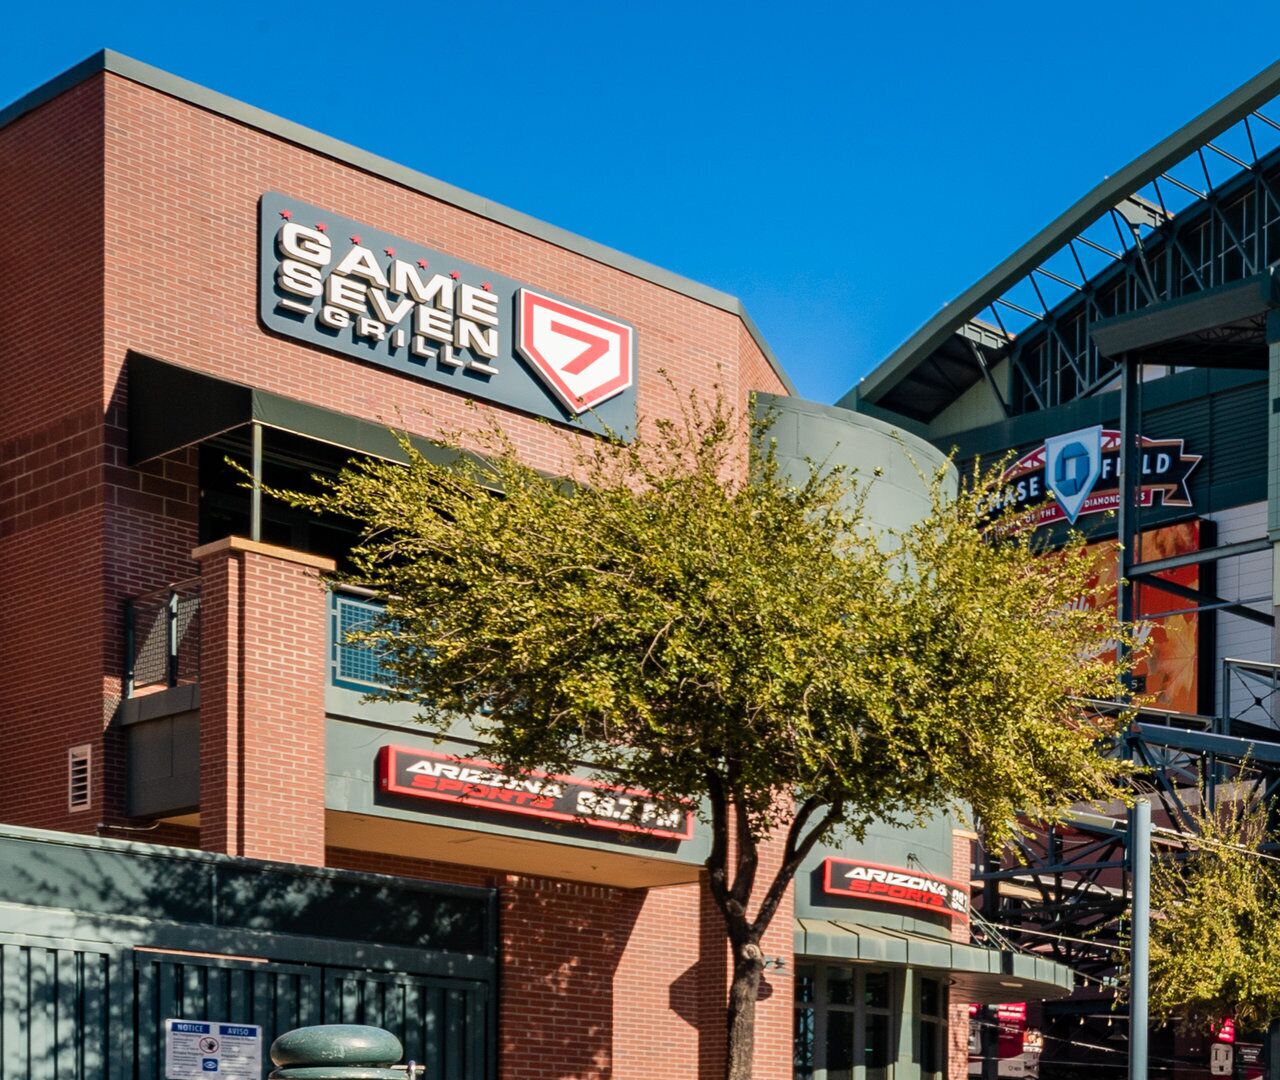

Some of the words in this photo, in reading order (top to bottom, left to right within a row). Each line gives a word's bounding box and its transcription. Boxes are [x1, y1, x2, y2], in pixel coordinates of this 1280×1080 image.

[279, 222, 499, 326] GAME
[278, 259, 499, 359] SEVEN
[320, 306, 464, 368] GRILL
[550, 320, 610, 375] 7
[1102, 453, 1170, 479] FILD
[1040, 508, 1056, 519] THE
[405, 760, 563, 798] ARIZONA
[410, 775, 554, 809] SPORTS
[844, 867, 948, 896] ARIZONA
[849, 880, 944, 906] SPORTS
[177, 1023, 203, 1033] NOTICE
[227, 1027, 249, 1036] AVISO
